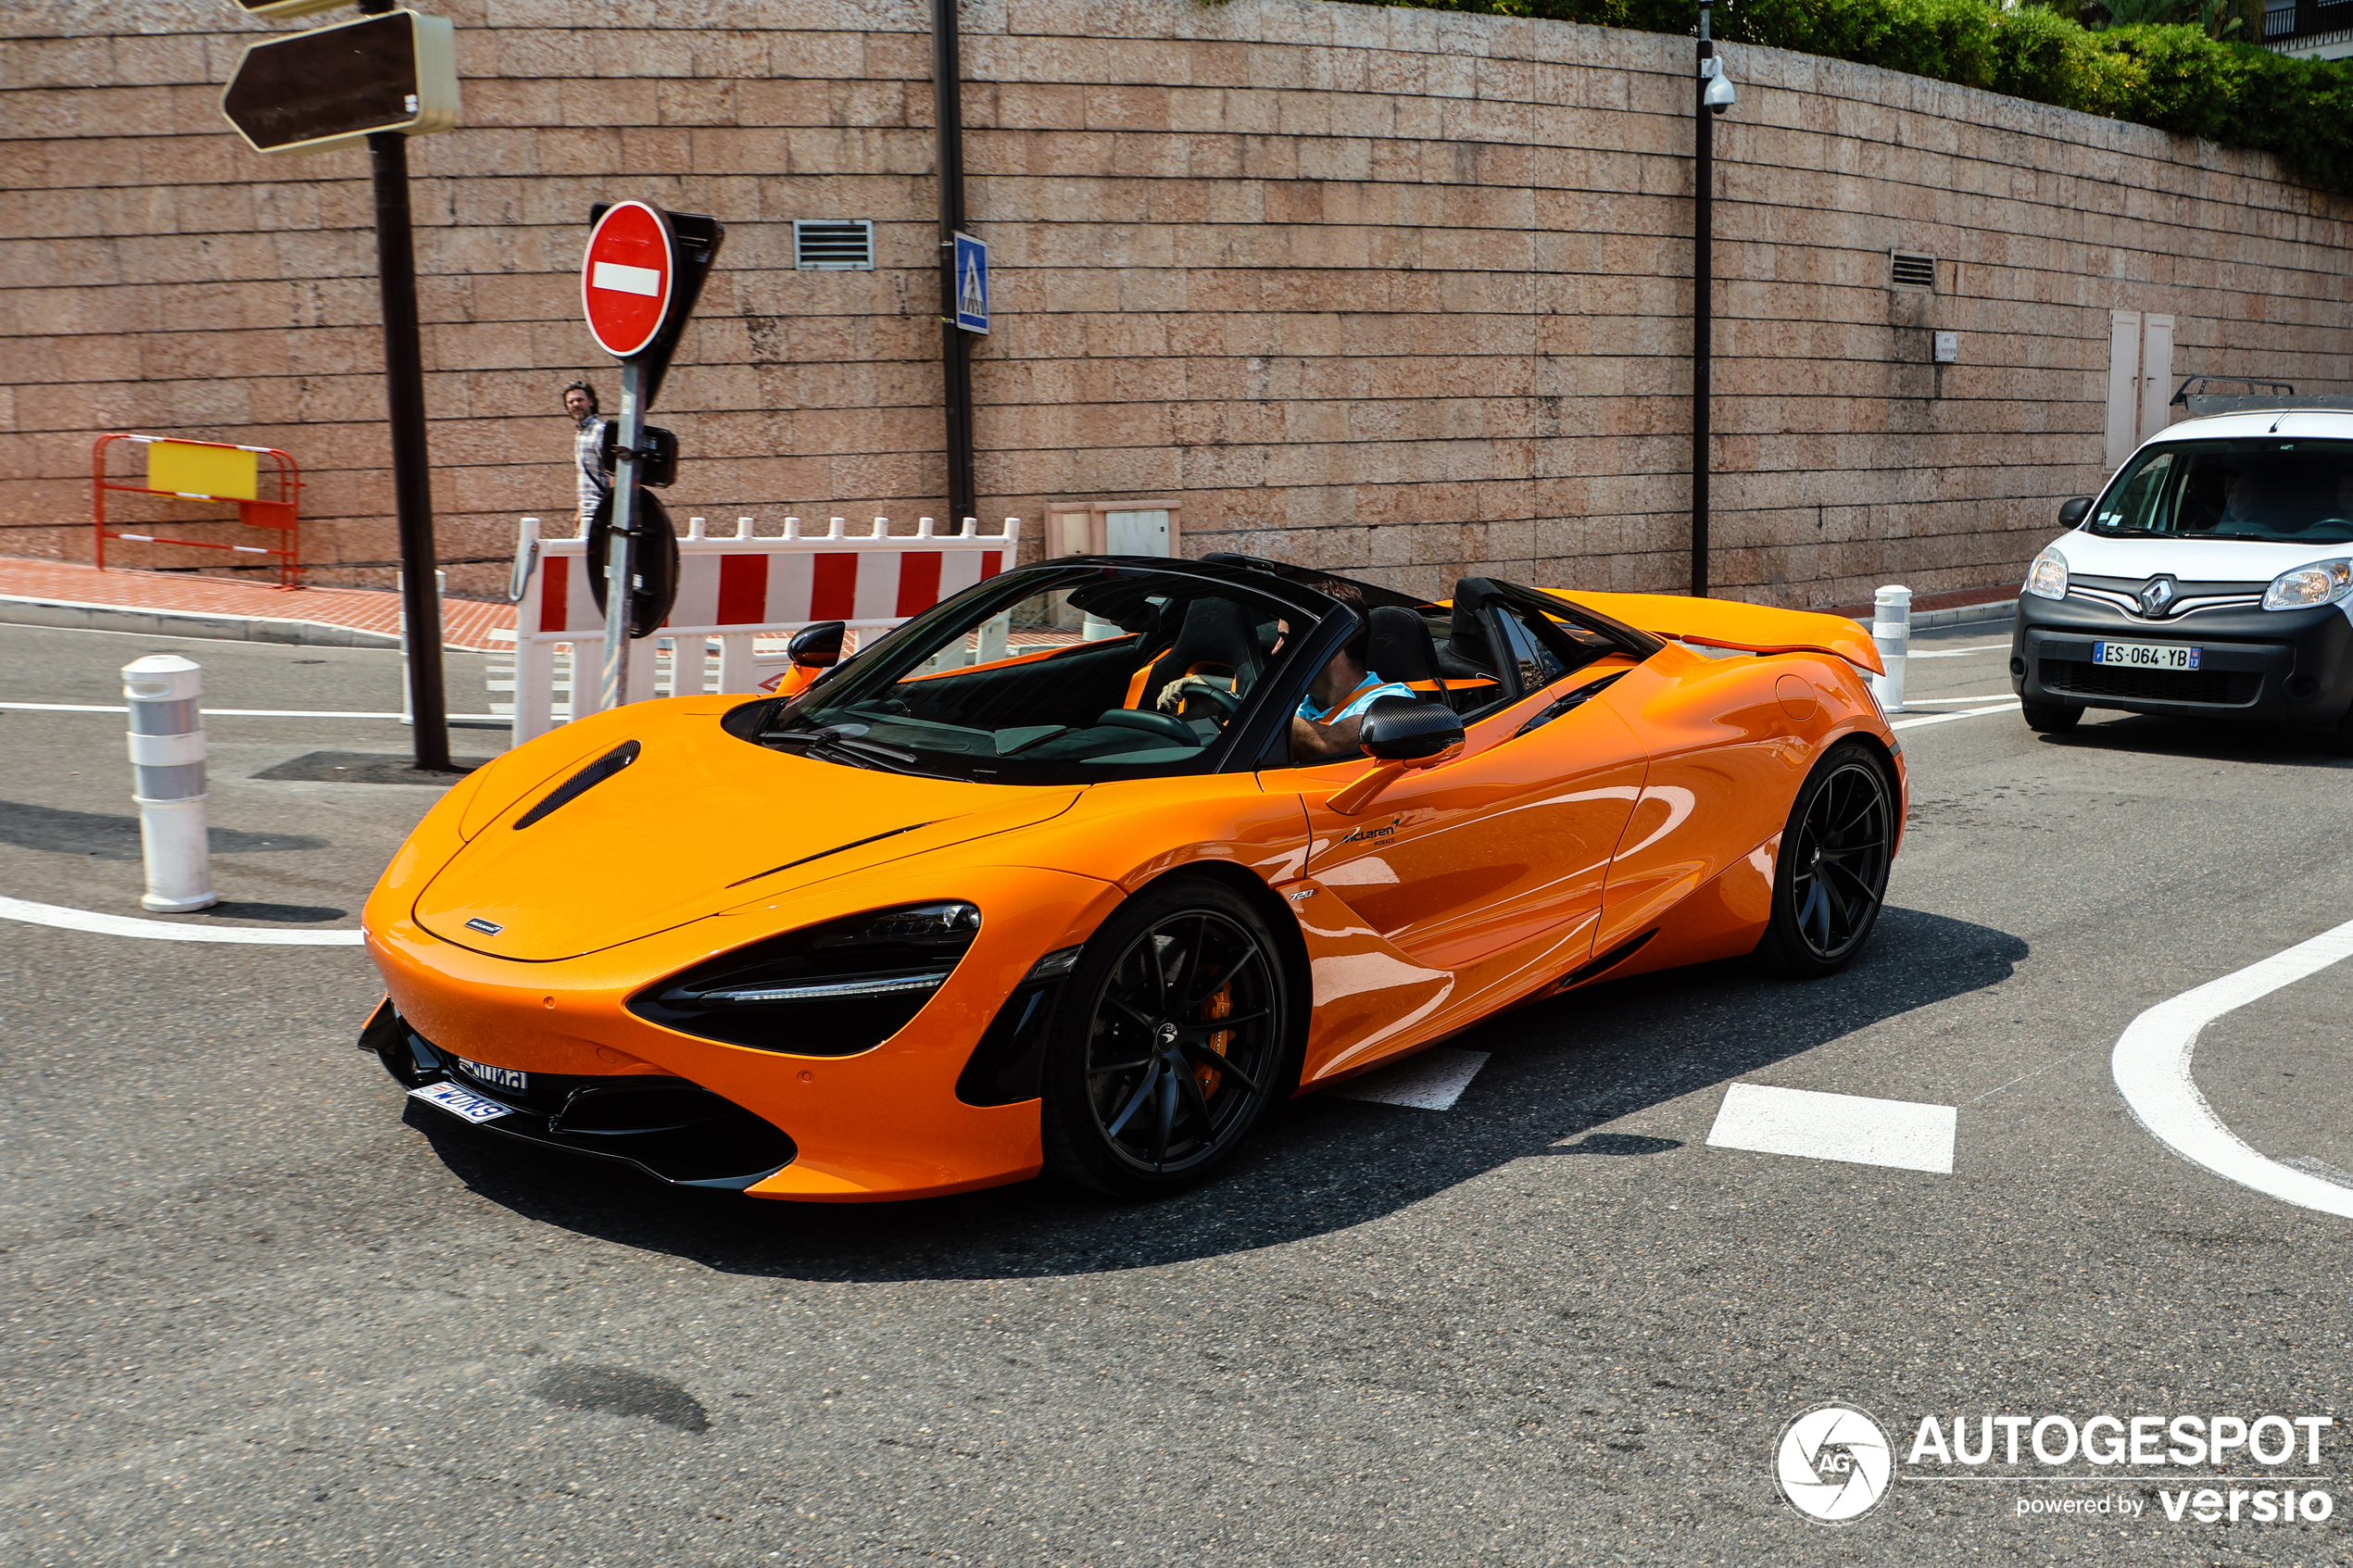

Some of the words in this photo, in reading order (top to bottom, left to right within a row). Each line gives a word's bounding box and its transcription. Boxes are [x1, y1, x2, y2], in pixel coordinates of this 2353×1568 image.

[2105, 646, 2187, 667] ES-064-YB
[2190, 659, 2198, 667] 13
[1340, 826, 1394, 844] McLaren
[1374, 837, 1395, 847] MONACO
[1290, 887, 1320, 901] 720S
